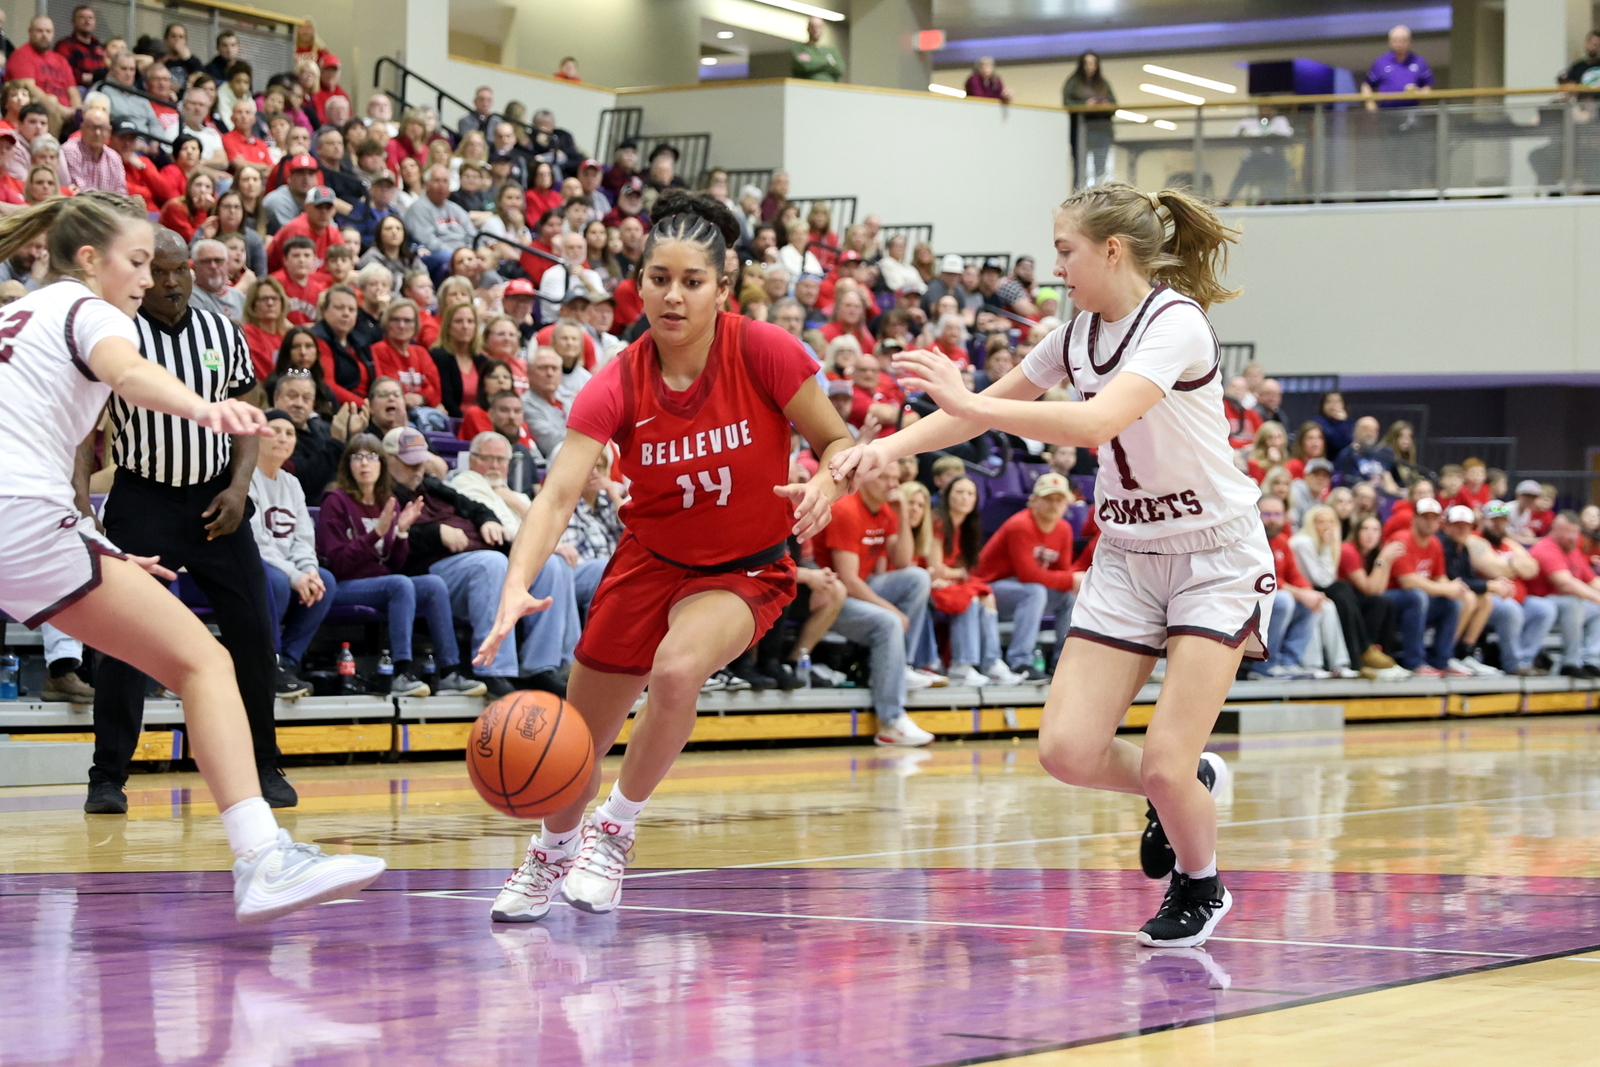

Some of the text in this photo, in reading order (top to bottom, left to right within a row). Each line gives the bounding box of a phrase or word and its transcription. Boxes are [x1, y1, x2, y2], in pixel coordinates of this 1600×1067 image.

[641, 419, 753, 466] BELLEVUE
[676, 466, 732, 509] 14
[264, 506, 296, 538] G
[1098, 489, 1203, 524] COMETS
[1254, 573, 1275, 595] G
